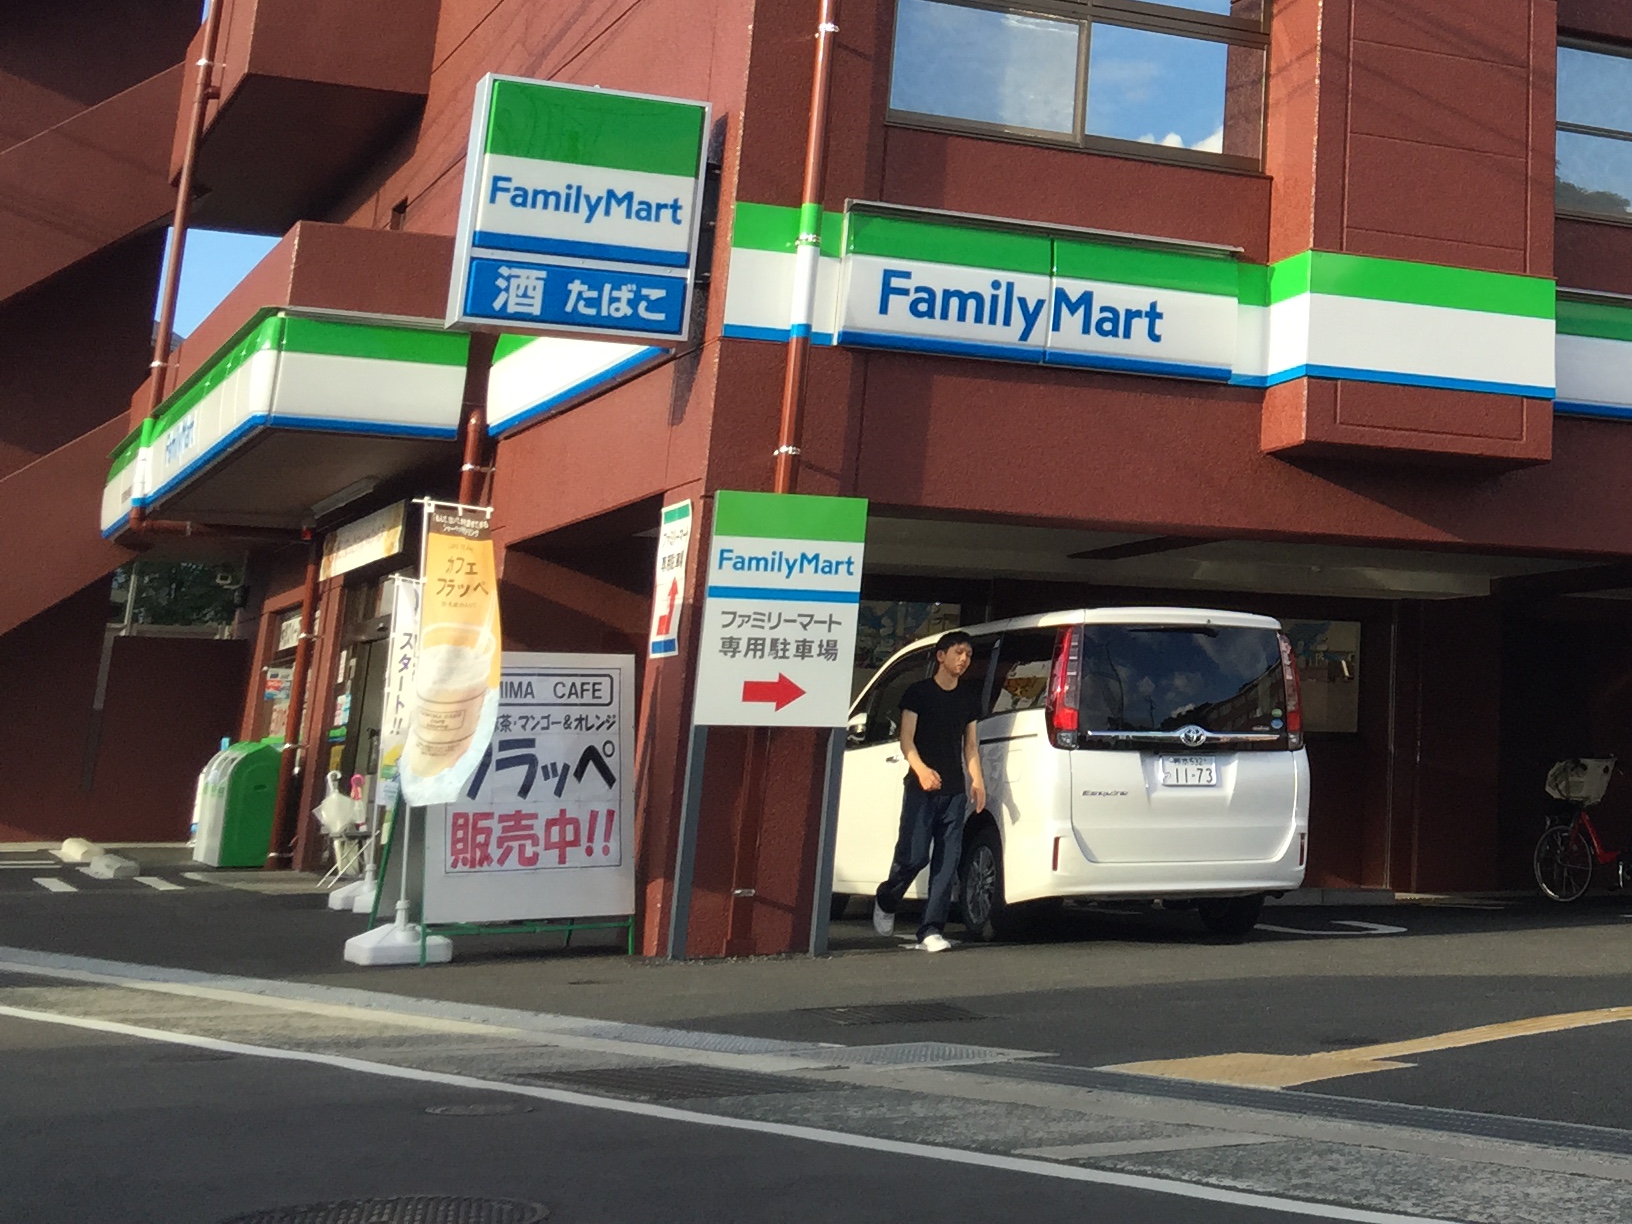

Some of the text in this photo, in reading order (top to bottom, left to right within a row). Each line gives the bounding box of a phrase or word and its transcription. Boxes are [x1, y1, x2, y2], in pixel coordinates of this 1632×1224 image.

[488, 175, 683, 224] FamilyMart
[493, 265, 667, 322] 酒 たばこ
[878, 268, 1164, 344] FamilyMart
[718, 548, 855, 579] FamilyMart
[436, 577, 489, 597] フラッペ
[720, 610, 843, 633] ファミリーマート
[718, 635, 839, 662] 専用駐車場
[552, 681, 603, 700] CAFE
[493, 713, 617, 734] 茶・マンゴー&オレンジ
[450, 808, 616, 869] 販売中!!
